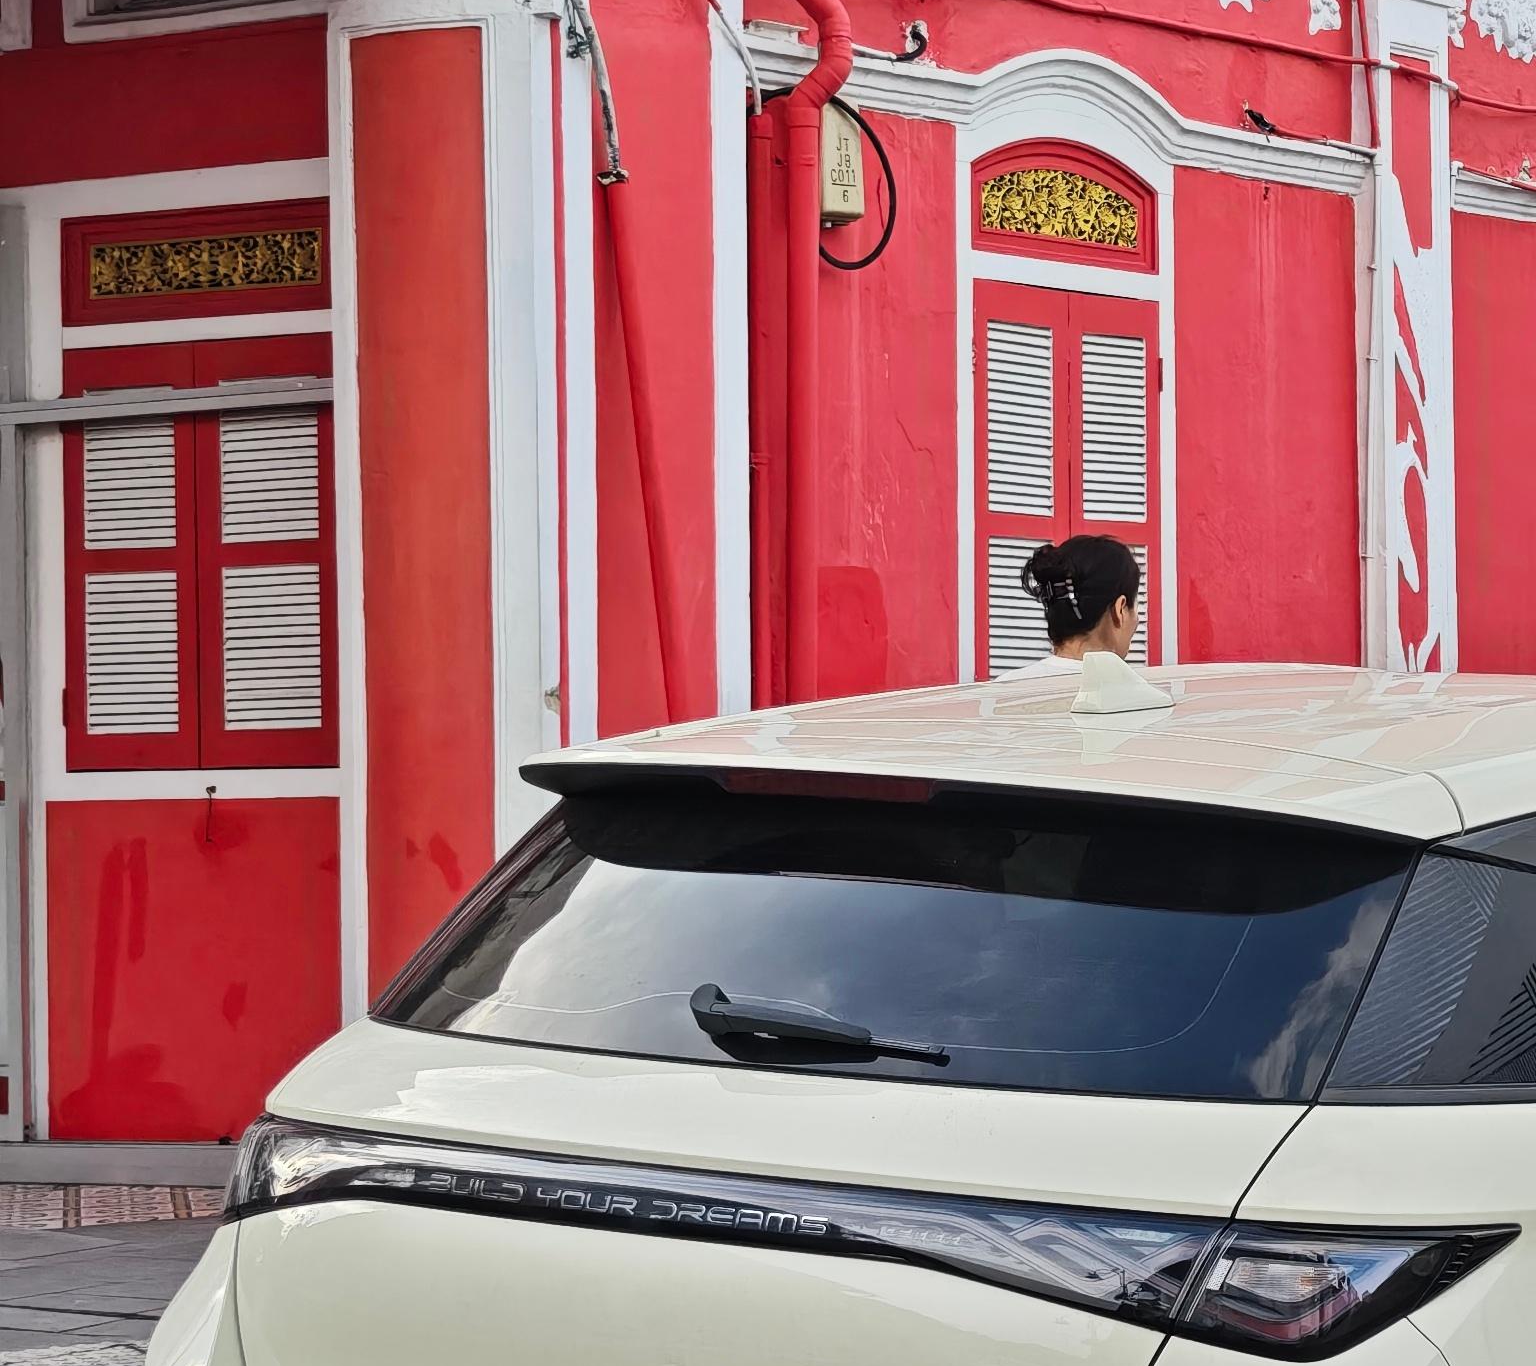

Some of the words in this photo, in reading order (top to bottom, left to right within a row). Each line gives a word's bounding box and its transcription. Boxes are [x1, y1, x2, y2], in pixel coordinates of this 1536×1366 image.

[837, 138, 850, 151] JT
[831, 169, 855, 182] C011
[843, 190, 849, 202] 6
[425, 1171, 526, 1204] BUILD
[536, 1186, 638, 1217] YOUR
[650, 1199, 831, 1236] DREAMS
